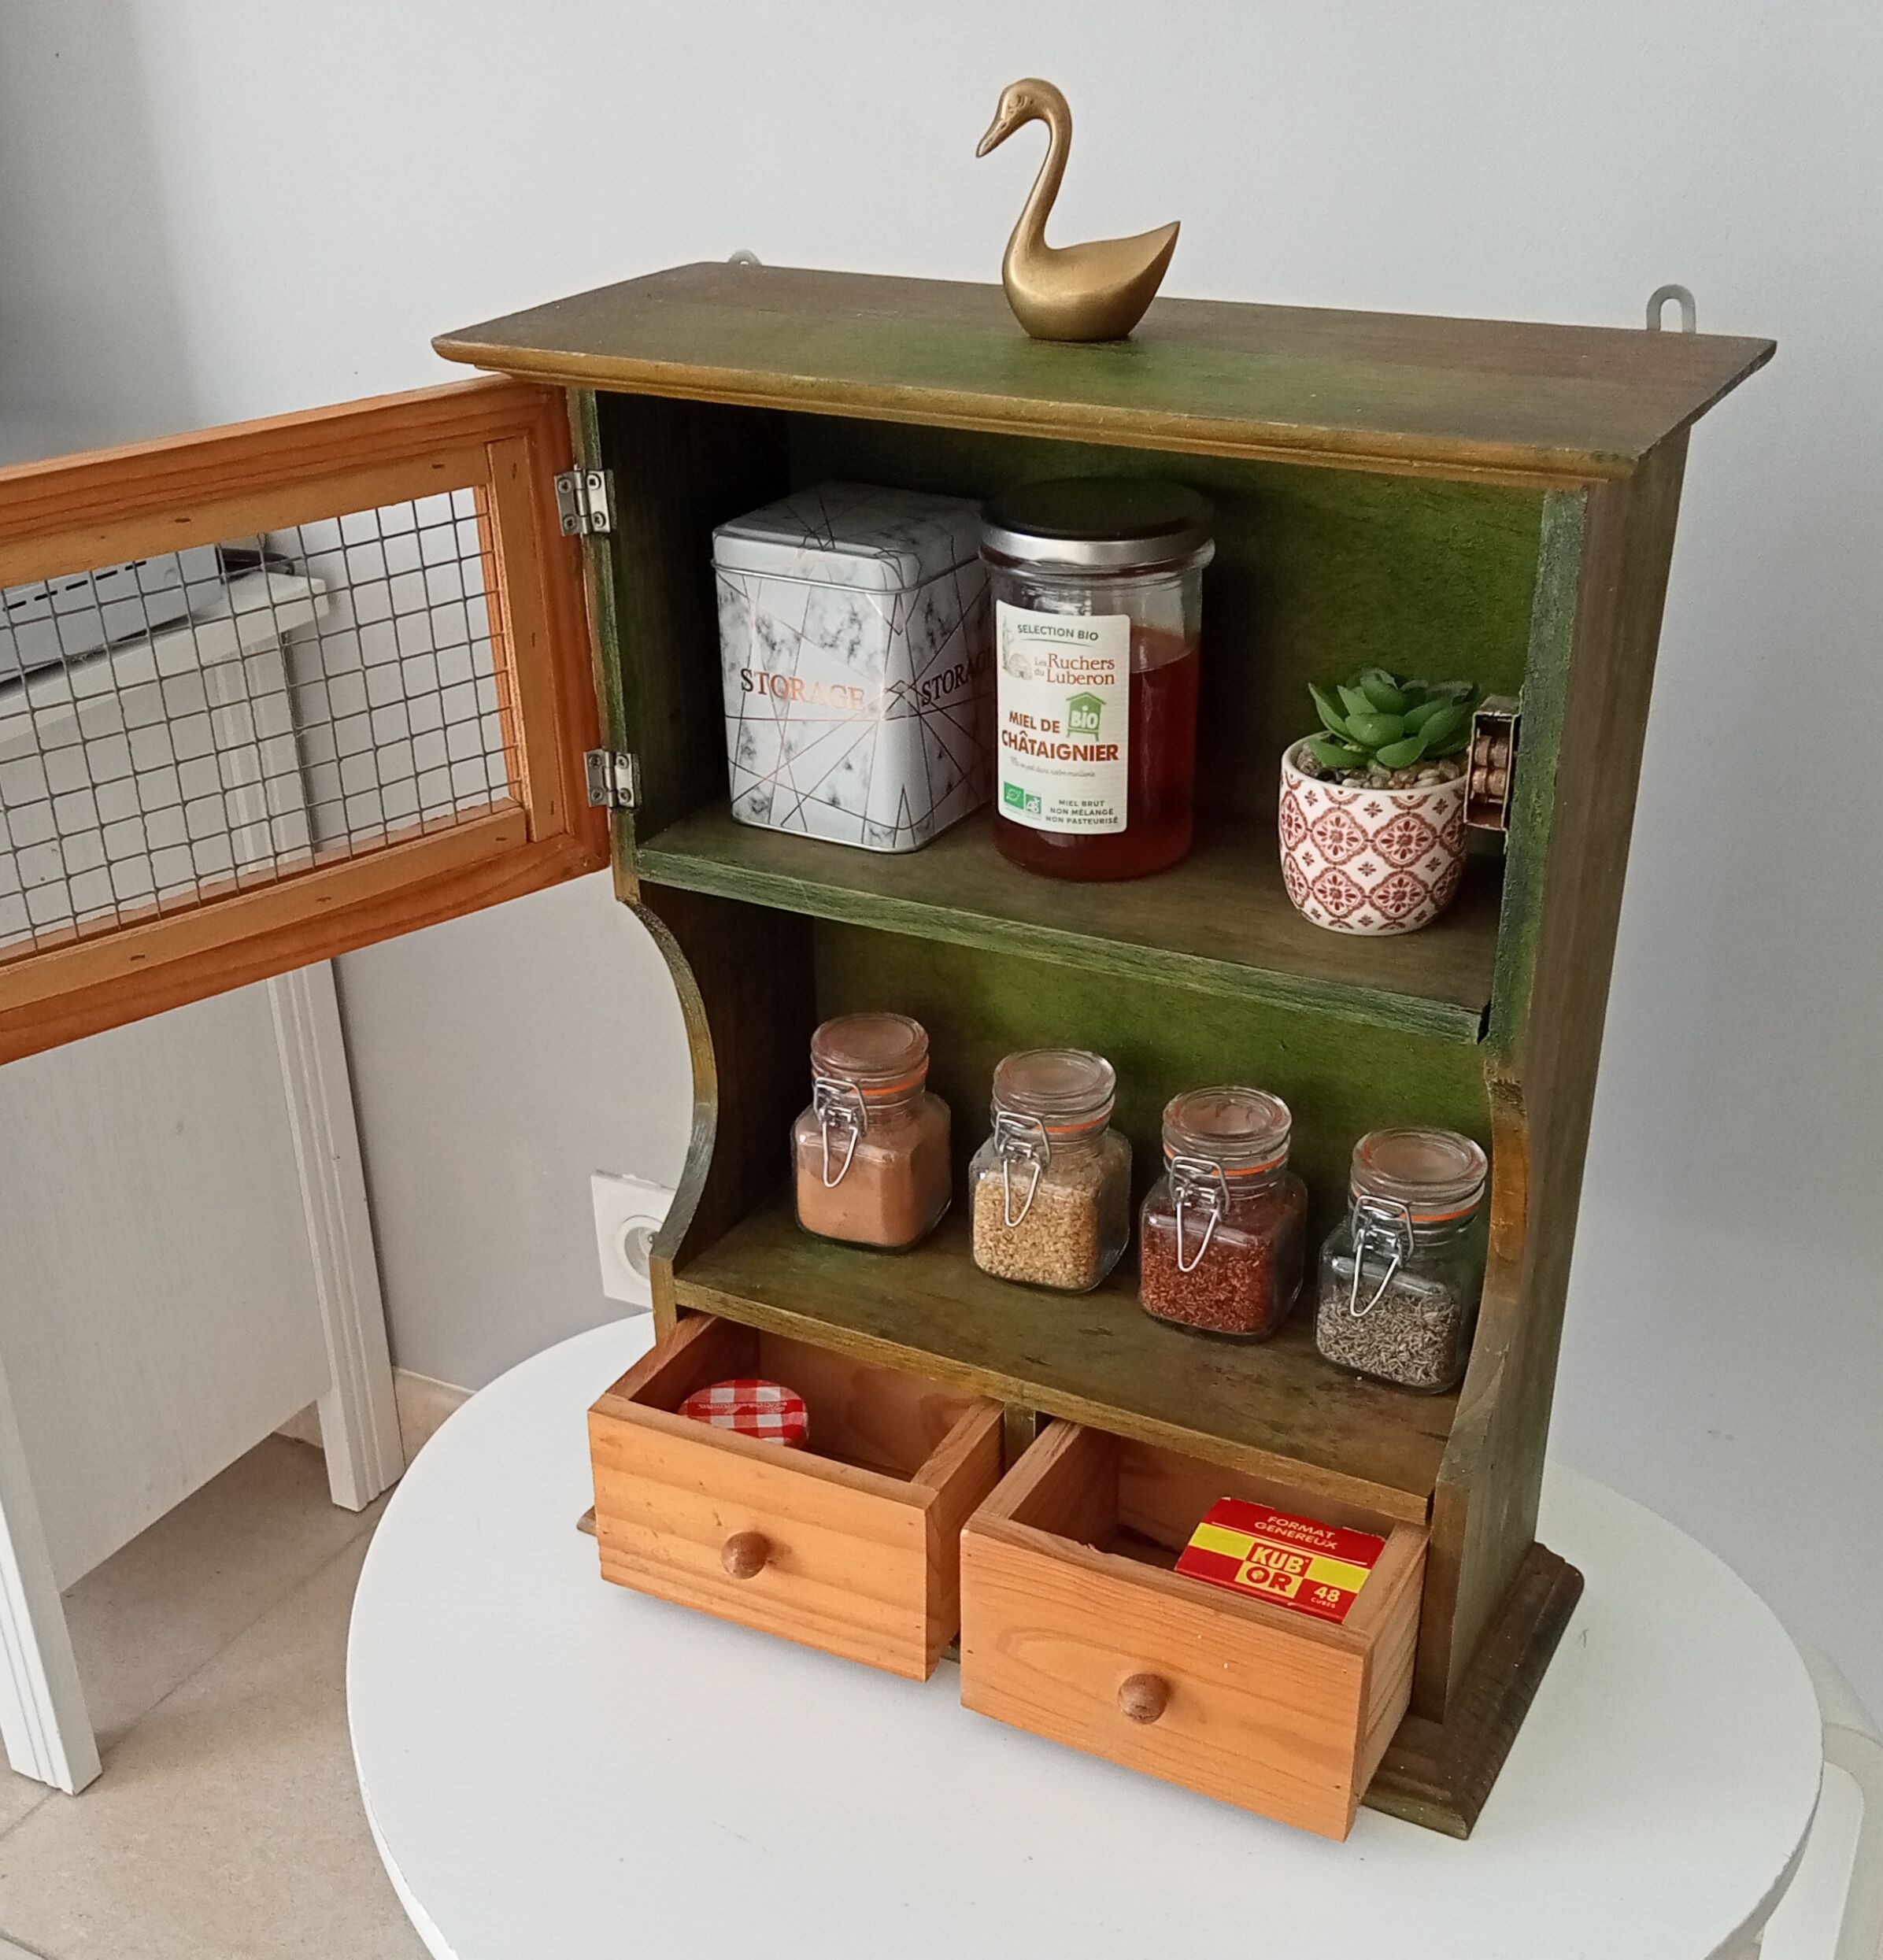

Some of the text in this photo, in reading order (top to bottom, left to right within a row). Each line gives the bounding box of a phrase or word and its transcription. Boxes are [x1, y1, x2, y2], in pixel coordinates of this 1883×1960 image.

[1018, 624, 1099, 641] SELECTION BIO
[1048, 653, 1115, 670] Ruchers
[741, 668, 865, 708] STORAGE
[1047, 669, 1115, 685] Luberon
[1009, 711, 1060, 733] MIEL DE
[1002, 730, 1119, 761] CHÂTAIGNIER
[1267, 1516, 1335, 1539] FORMAT
[1251, 1546, 1304, 1574] KUB
[1246, 1566, 1293, 1592] OR
[1314, 1586, 1341, 1603] 48
